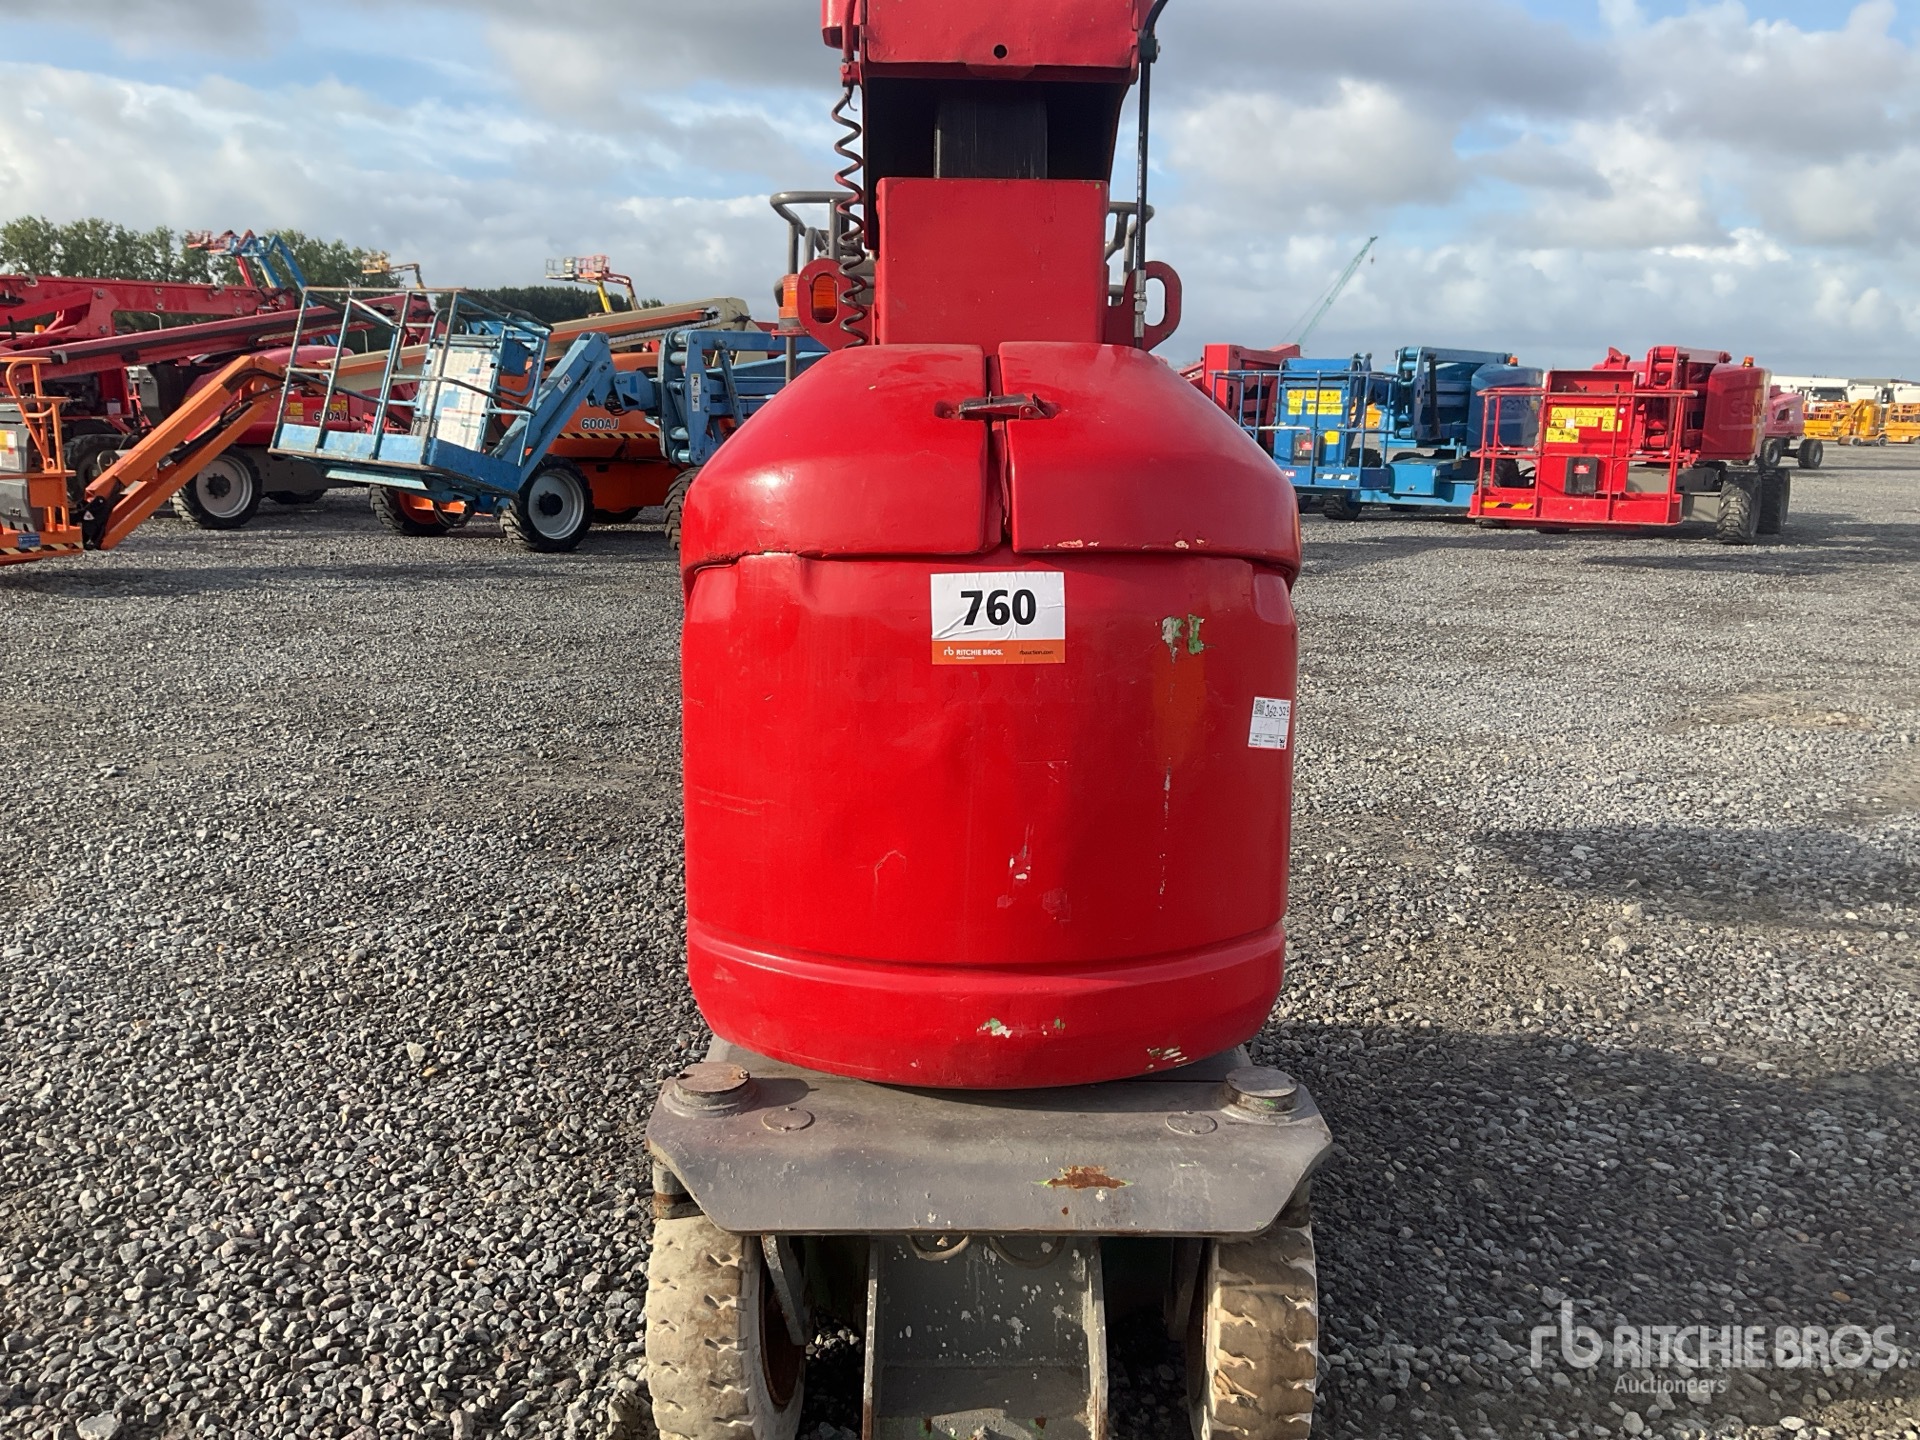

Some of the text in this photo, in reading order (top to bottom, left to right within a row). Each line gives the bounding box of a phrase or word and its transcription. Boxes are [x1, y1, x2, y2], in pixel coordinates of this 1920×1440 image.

[313, 411, 348, 422] 60AJ
[581, 418, 620, 430] 600AJ
[960, 588, 1037, 626] 760
